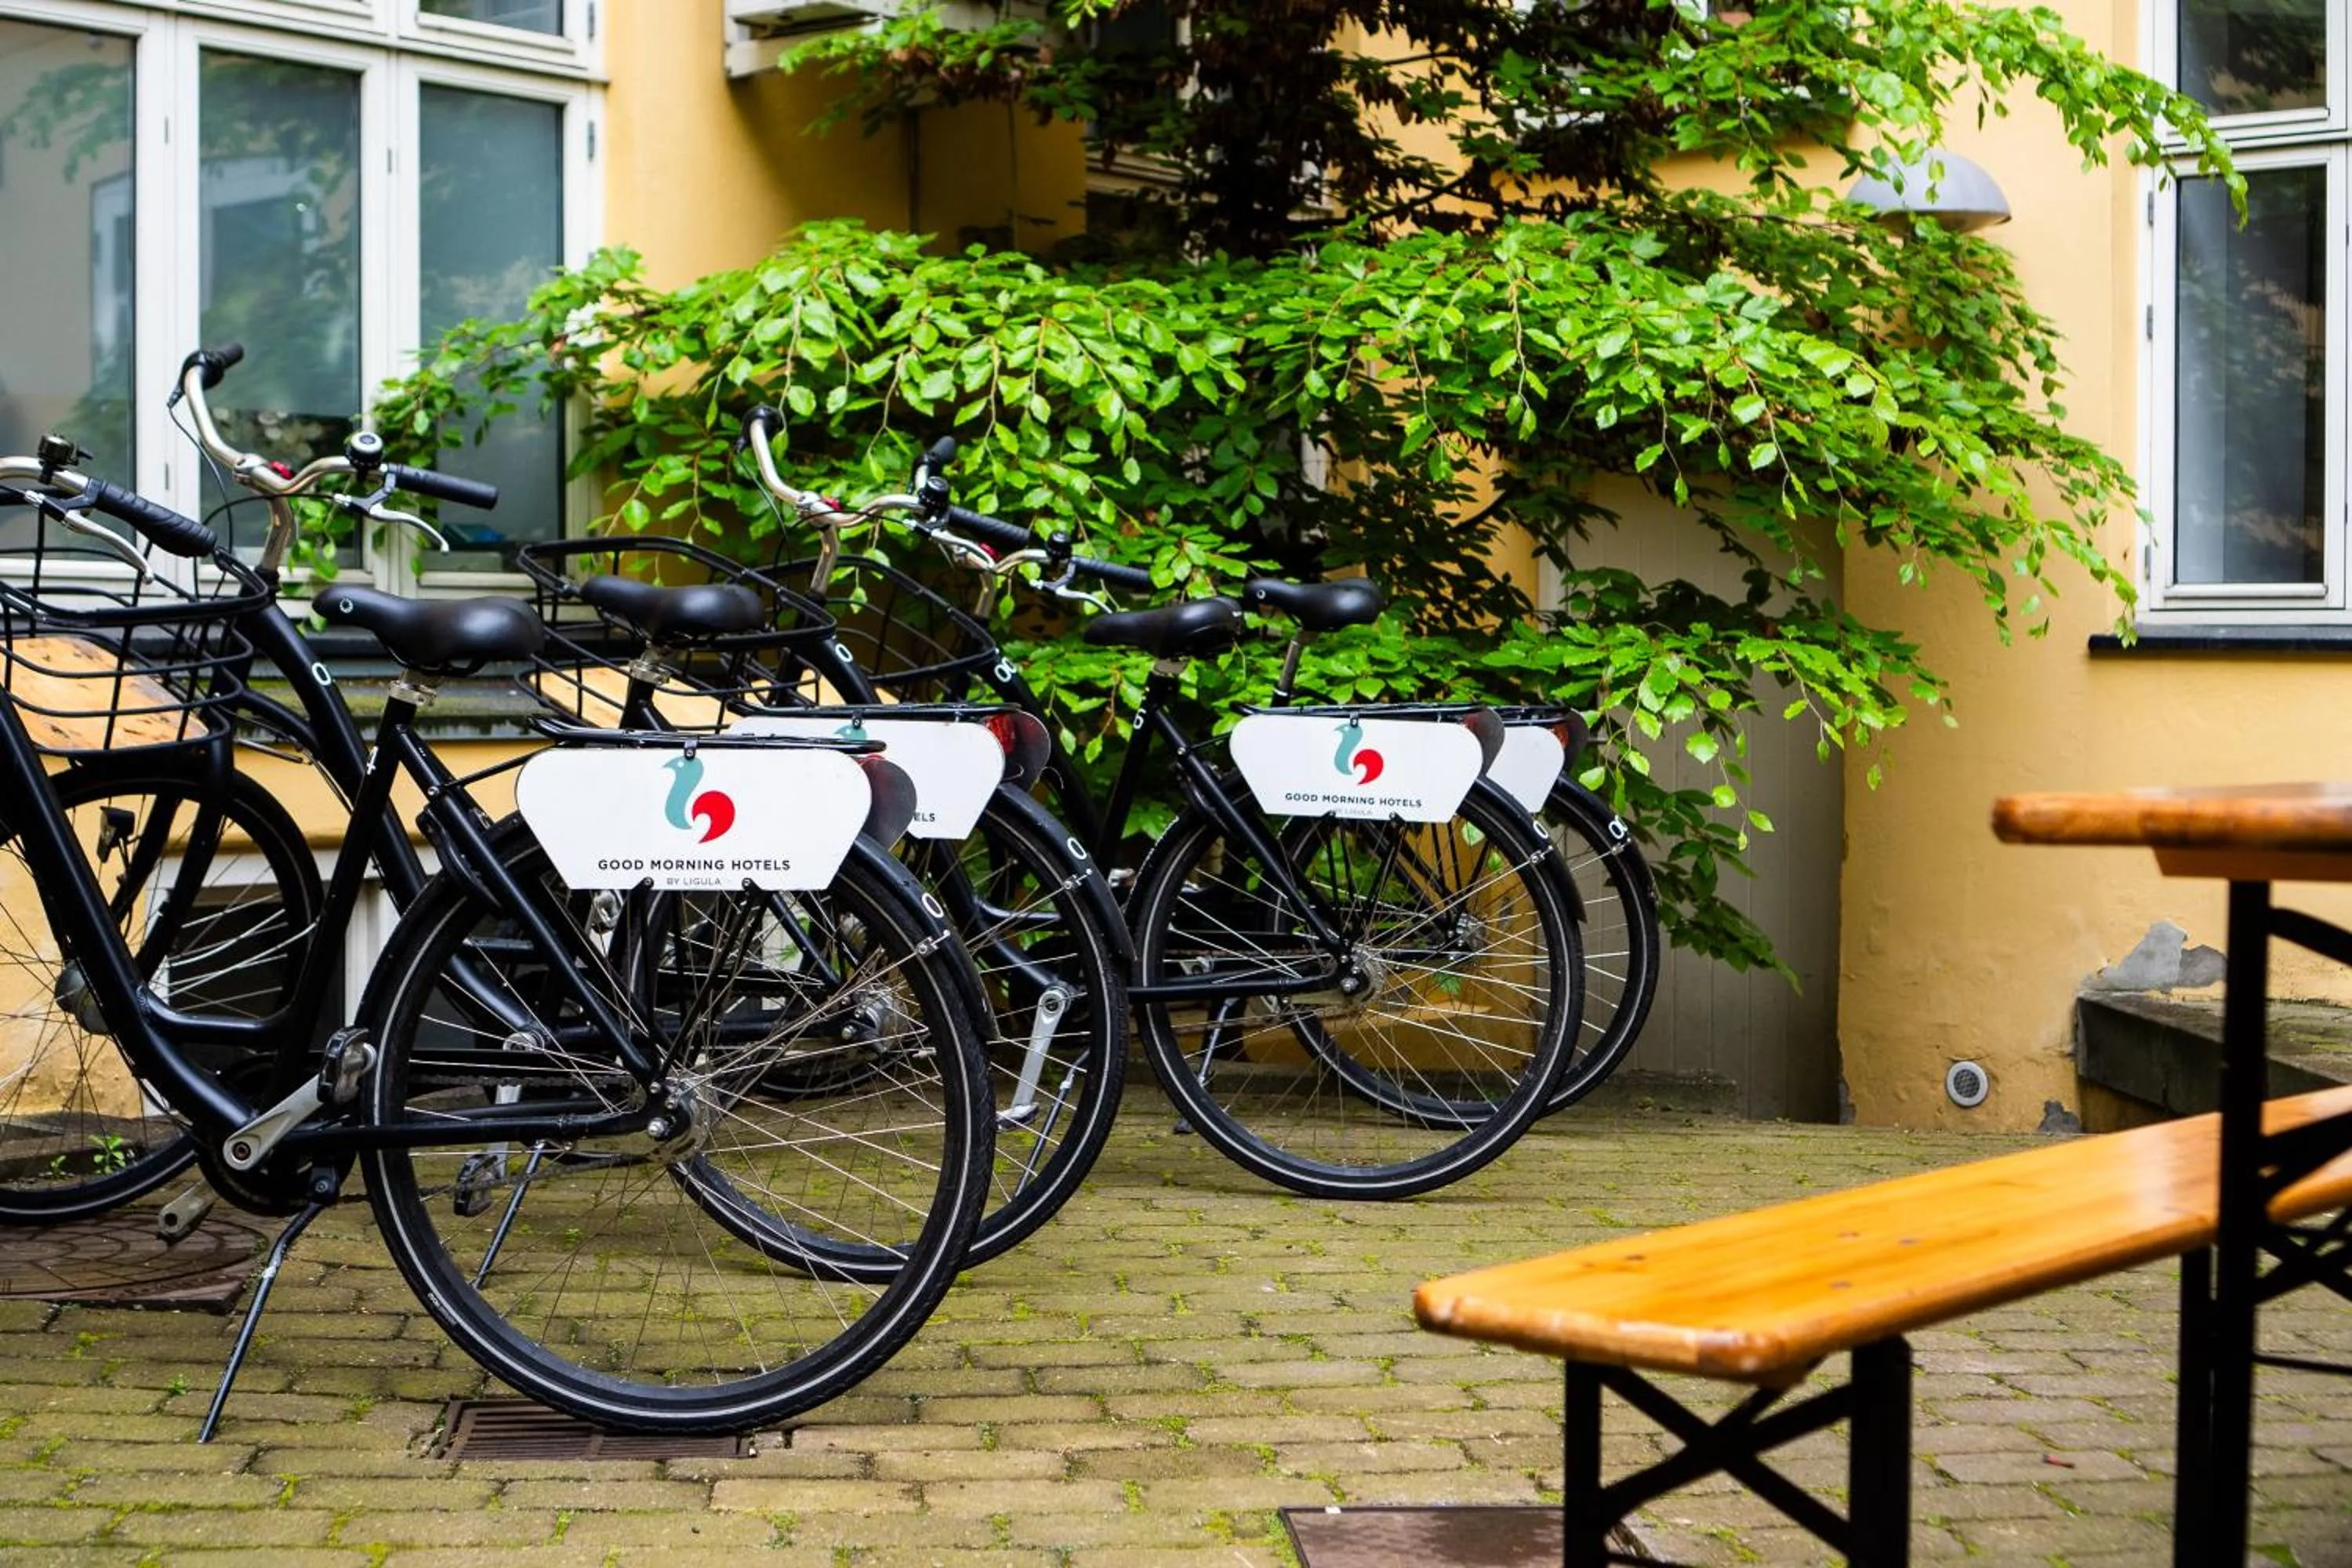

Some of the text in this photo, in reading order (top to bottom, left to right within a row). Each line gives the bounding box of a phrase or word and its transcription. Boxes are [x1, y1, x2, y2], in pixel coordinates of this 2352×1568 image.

[1285, 793, 1422, 808] GOOD MORNING HOTELS
[913, 811, 935, 822] ELS
[598, 859, 791, 871] GOOD MORNING HOTELS
[683, 877, 722, 886] LIGULA
